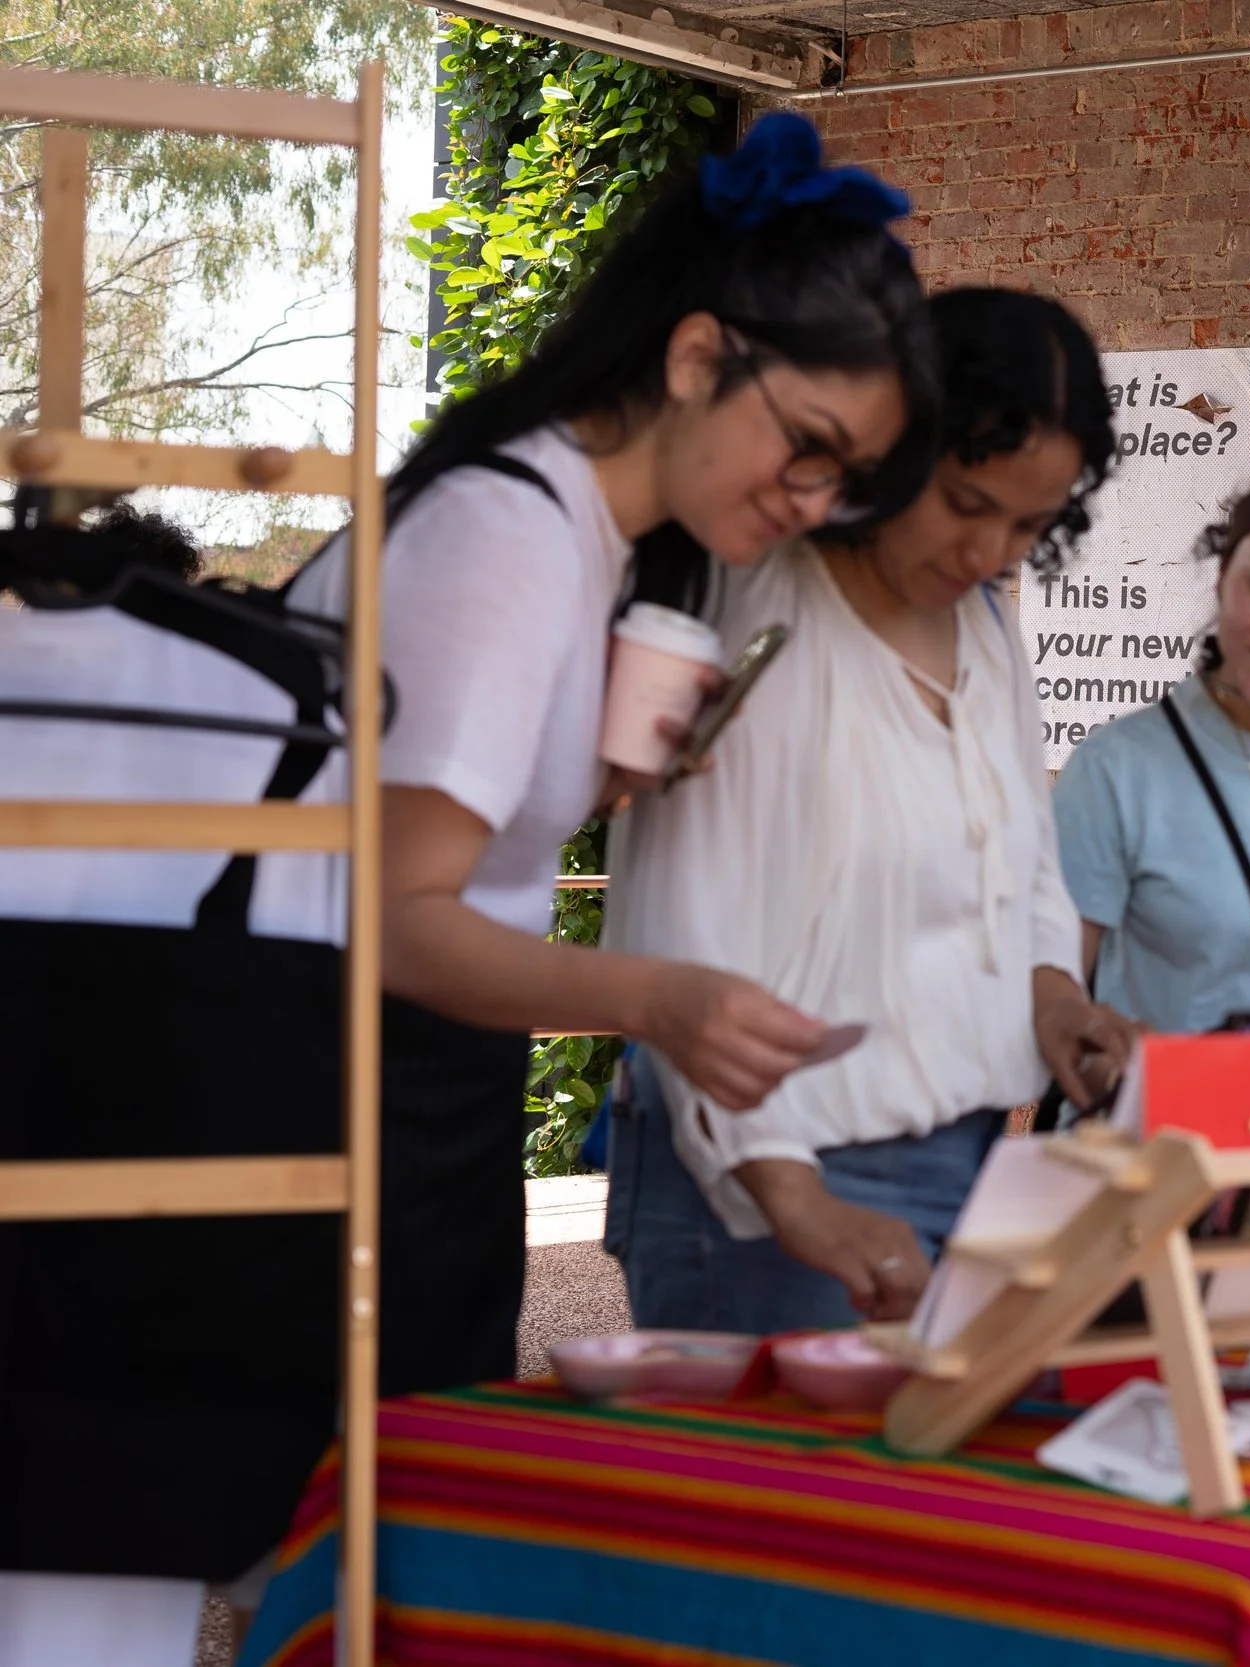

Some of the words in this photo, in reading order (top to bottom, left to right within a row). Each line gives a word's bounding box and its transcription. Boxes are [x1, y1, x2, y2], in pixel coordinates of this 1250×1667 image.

[1149, 373, 1178, 407] is
[1115, 421, 1238, 465] place?
[1038, 575, 1109, 609] This
[1121, 576, 1147, 609] is
[1035, 633, 1113, 664] your
[1121, 634, 1195, 659] new
